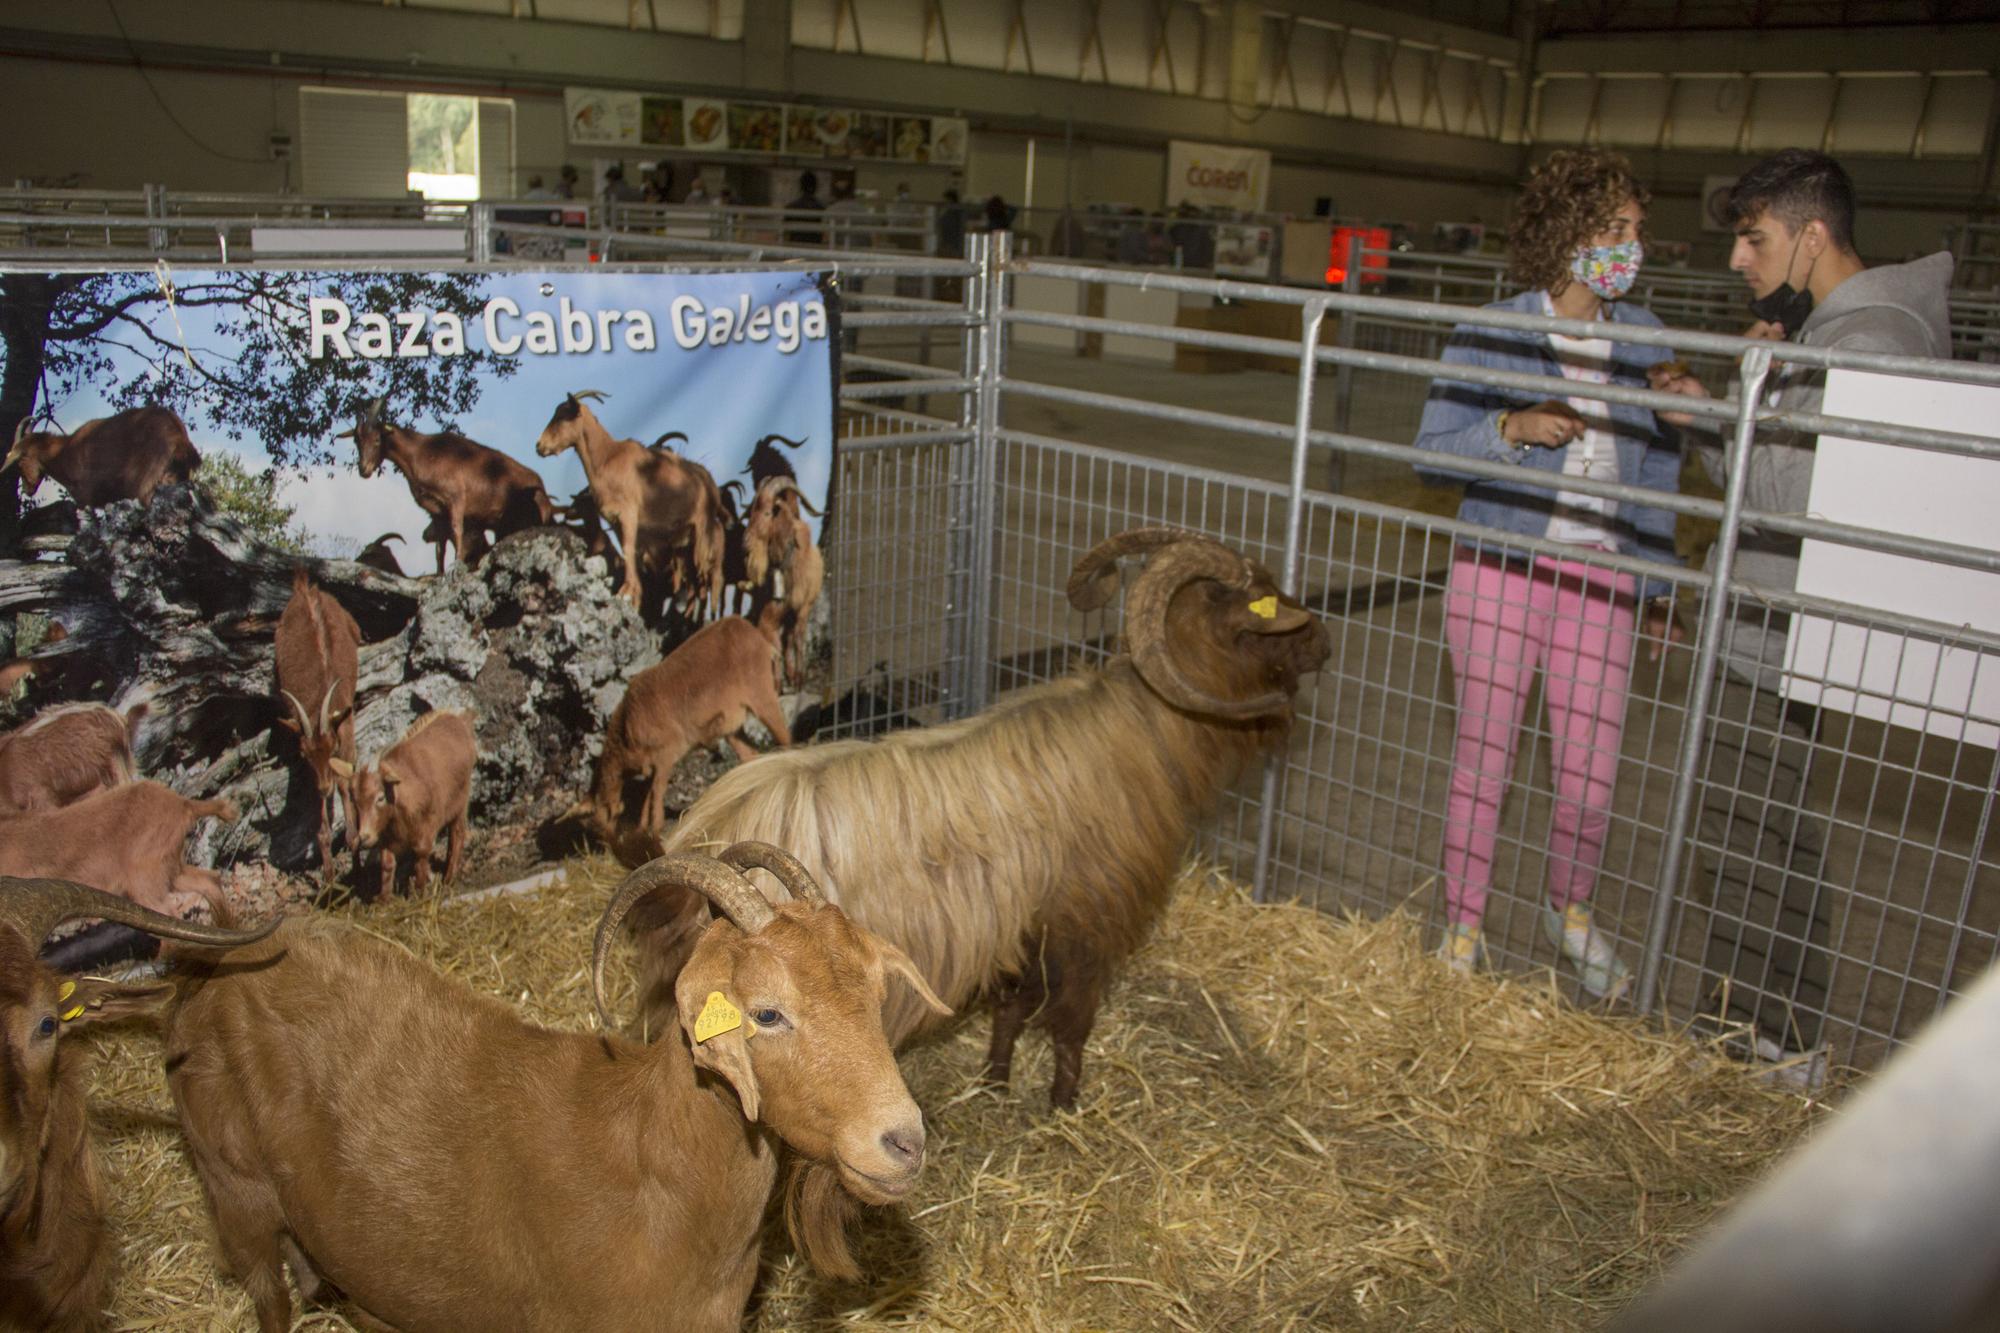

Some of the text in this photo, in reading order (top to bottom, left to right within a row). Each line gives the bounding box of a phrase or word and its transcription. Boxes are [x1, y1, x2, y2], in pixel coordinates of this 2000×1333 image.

[309, 294, 829, 359] Raza Cabra Galega
